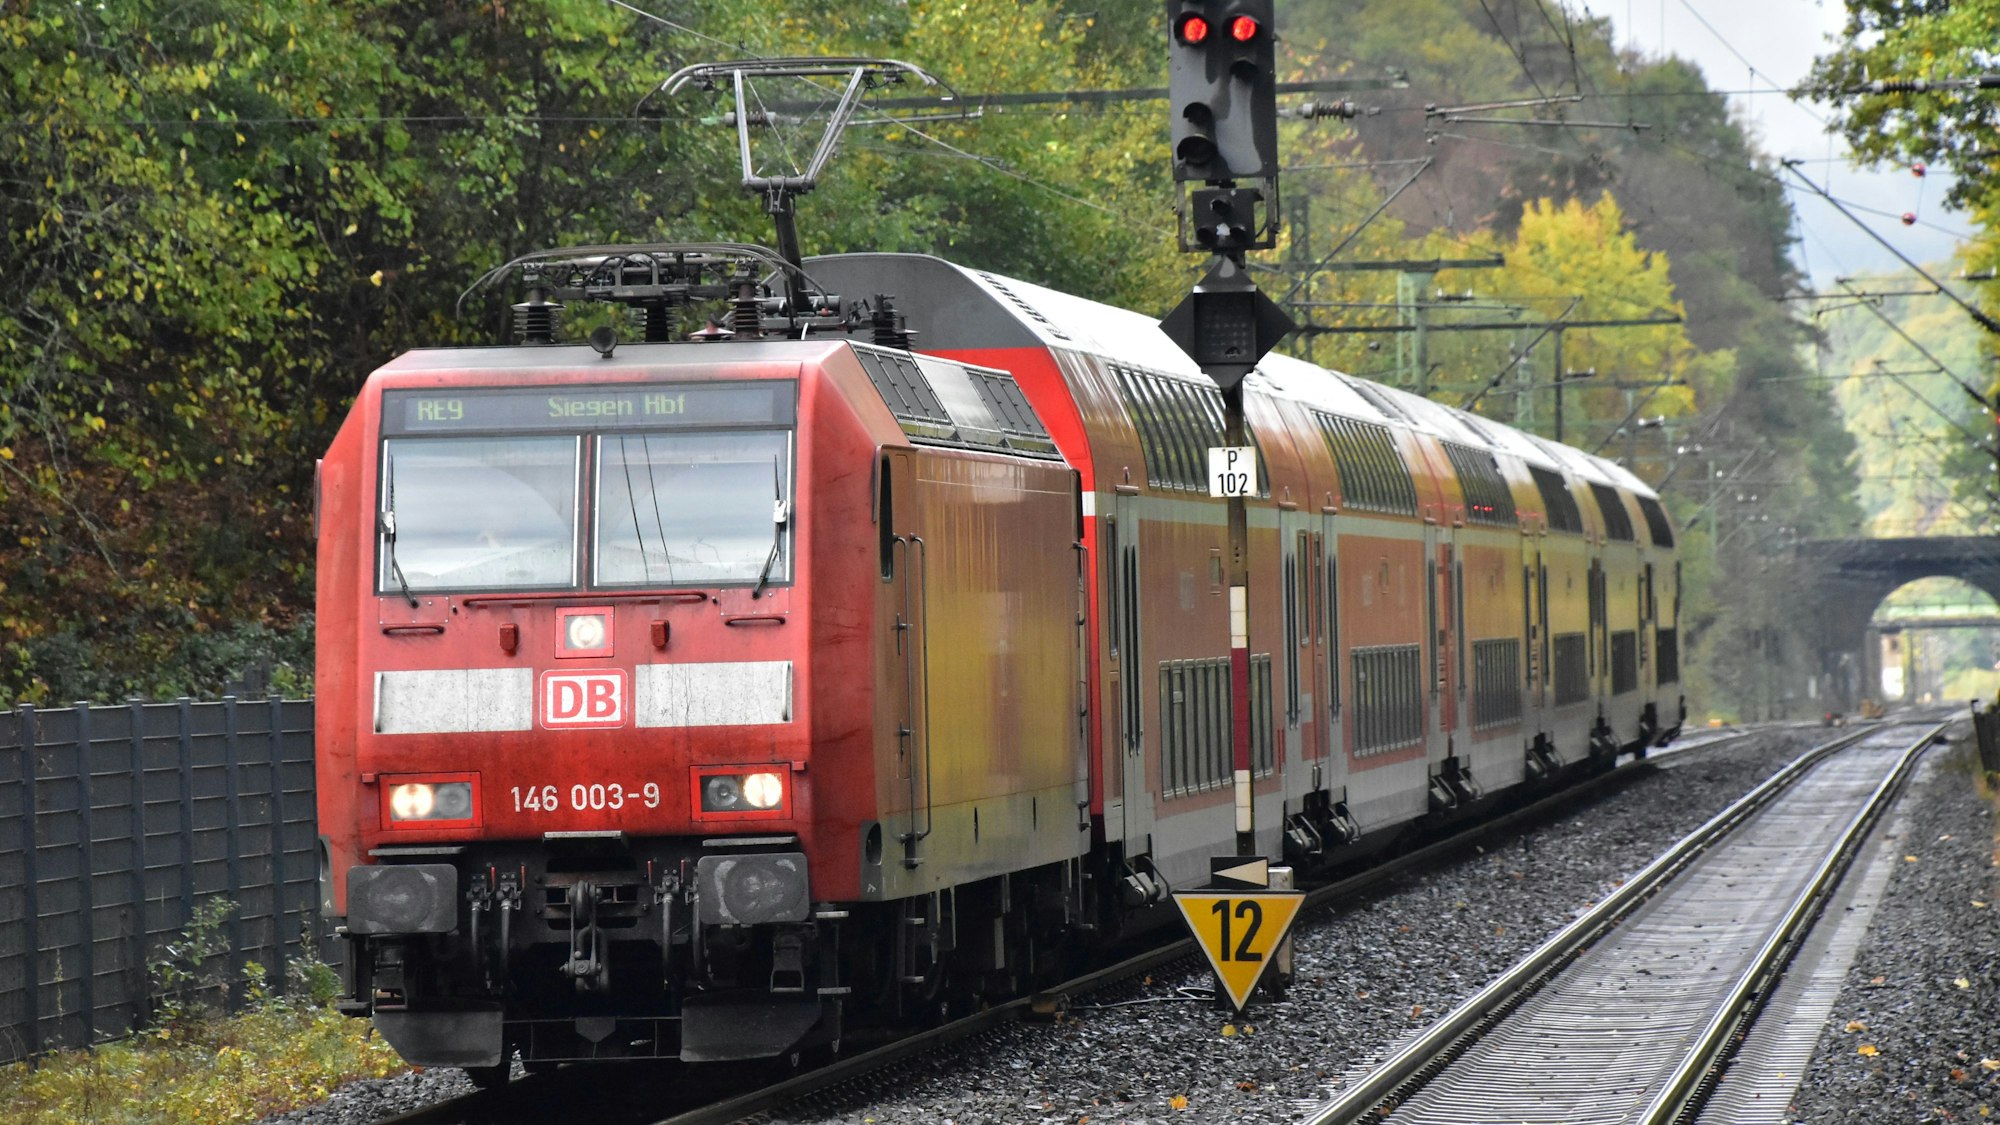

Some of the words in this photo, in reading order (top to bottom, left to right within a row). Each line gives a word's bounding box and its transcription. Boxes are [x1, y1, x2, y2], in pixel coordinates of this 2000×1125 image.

[417, 399, 464, 421] RE9
[548, 396, 633, 418] Siegen
[645, 394, 687, 416] Hbf
[1227, 450, 1238, 471] P
[1217, 473, 1248, 494] 102
[552, 679, 617, 718] DB
[510, 785, 559, 813] 146
[570, 783, 660, 811] 003-9
[1212, 899, 1263, 962] 12
